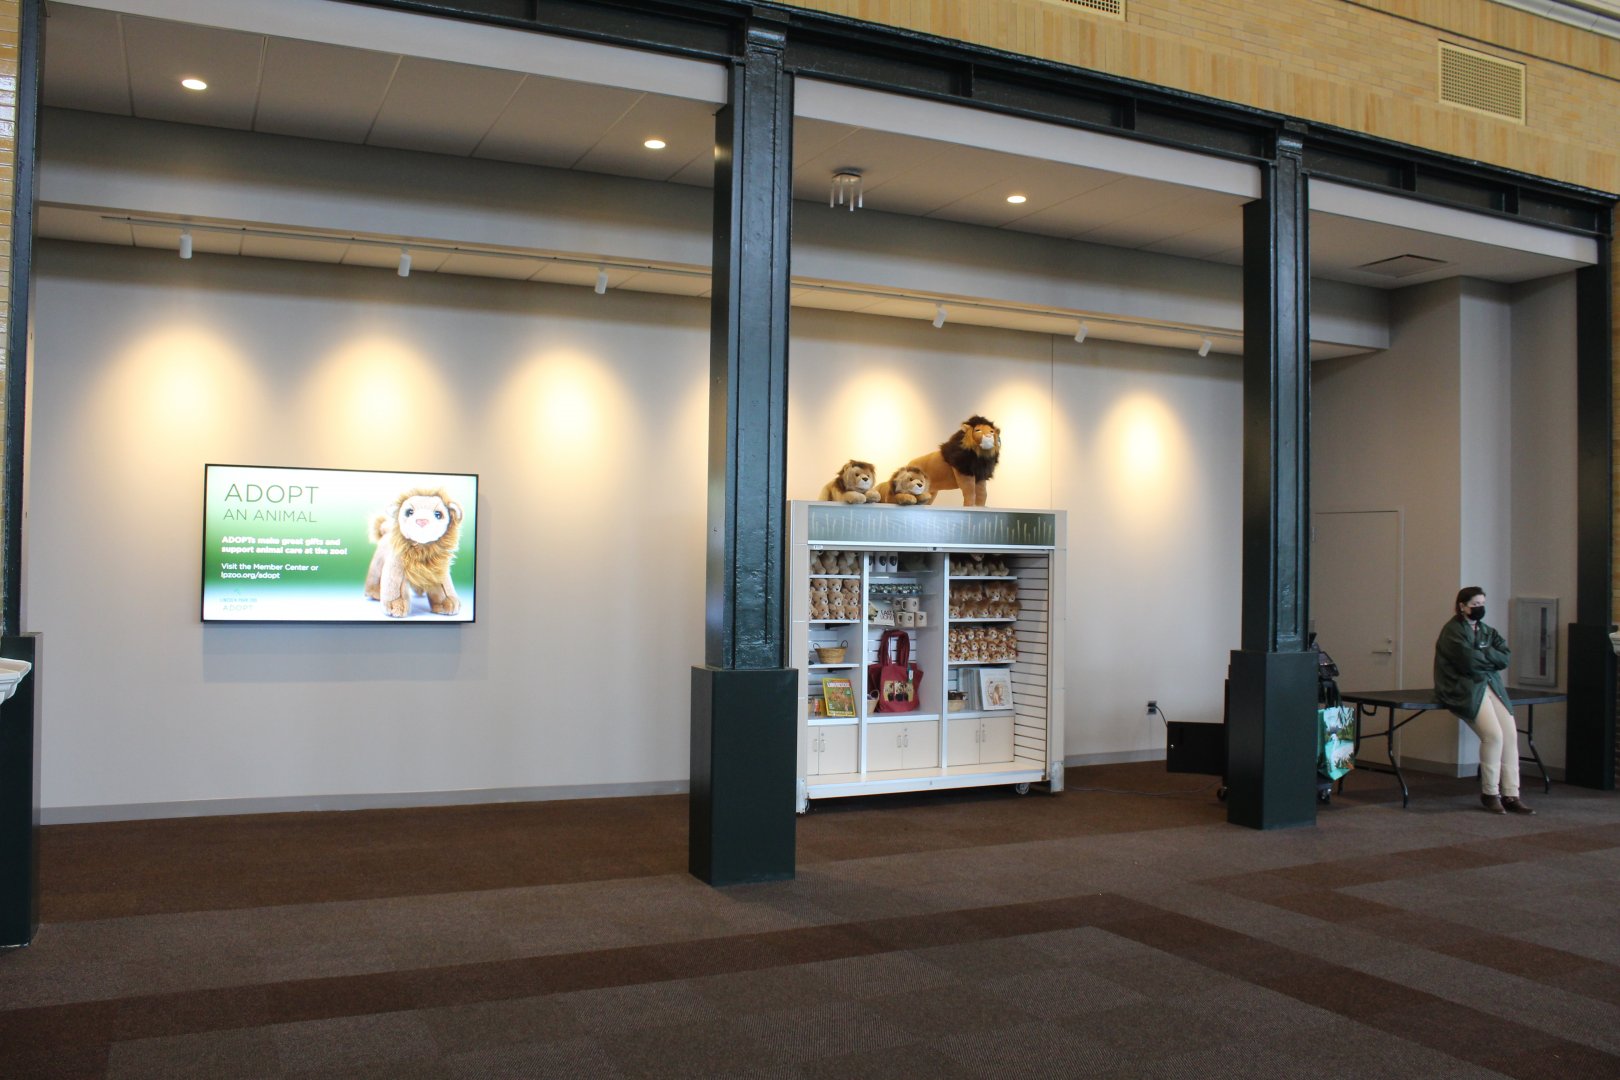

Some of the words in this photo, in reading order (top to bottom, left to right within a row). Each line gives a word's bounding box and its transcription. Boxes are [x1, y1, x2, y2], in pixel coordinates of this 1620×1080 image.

[224, 483, 319, 504] ADOPT
[223, 508, 247, 521] AN
[253, 509, 318, 522] ANIMAL
[257, 537, 280, 545] make
[281, 538, 303, 546] great
[304, 538, 324, 547] gifts
[324, 538, 341, 546] and
[221, 546, 254, 554] support
[255, 546, 283, 554] animal
[284, 547, 303, 555] care
[304, 547, 313, 555] at
[314, 547, 328, 555] the
[253, 563, 283, 571] Member
[284, 563, 309, 571] Center
[221, 571, 280, 580] lpzoo.org/adopt
